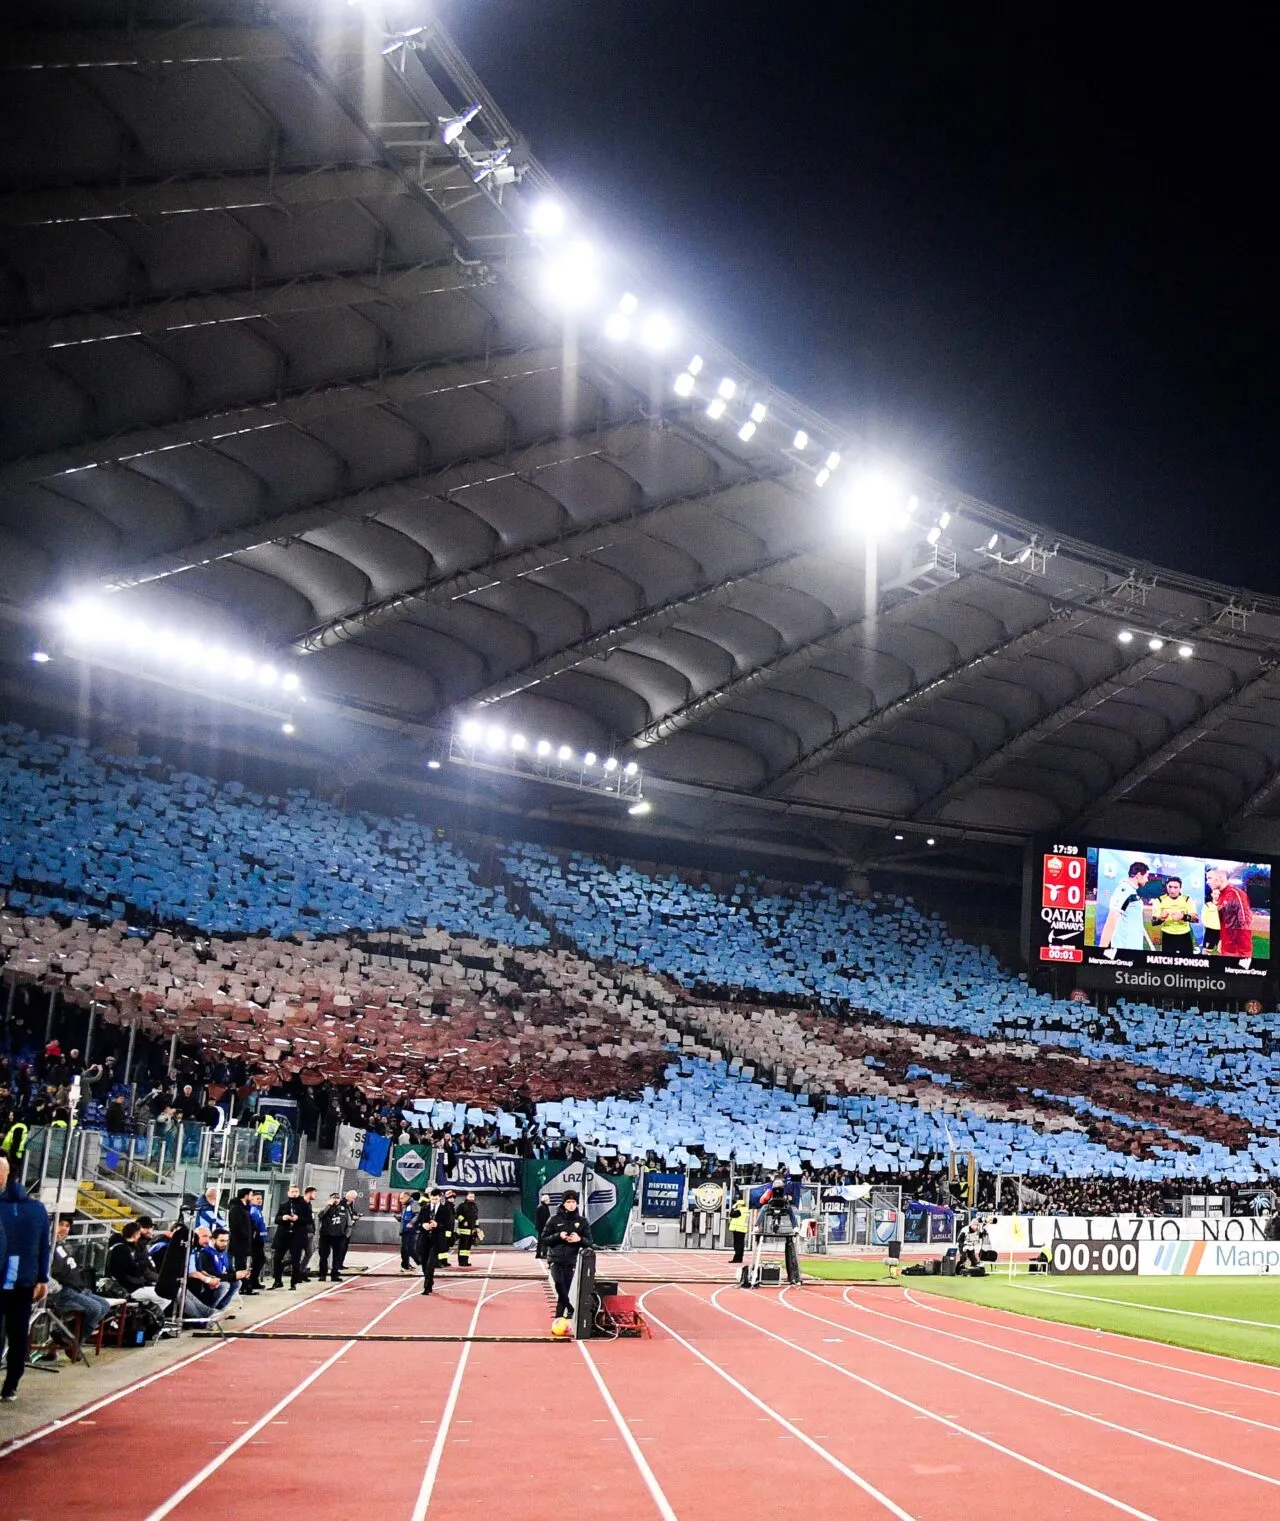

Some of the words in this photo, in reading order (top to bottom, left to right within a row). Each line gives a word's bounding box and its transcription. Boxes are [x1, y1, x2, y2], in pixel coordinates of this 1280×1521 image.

[1053, 845, 1078, 855] 17:59
[1068, 861, 1081, 879] 0
[1067, 886, 1080, 904] 0
[1041, 908, 1084, 923] QATAR
[1051, 921, 1085, 931] AIRWAYS
[1048, 950, 1074, 960] 00:01
[1146, 955, 1173, 966] MATCH
[1174, 957, 1210, 968] SPONSOR
[1115, 970, 1162, 987] Stadio
[1163, 974, 1226, 992] Olimpico
[563, 1172, 594, 1183] LAZO
[648, 1182, 679, 1190] DISTINTI
[1054, 1243, 1137, 1271] 00:00
